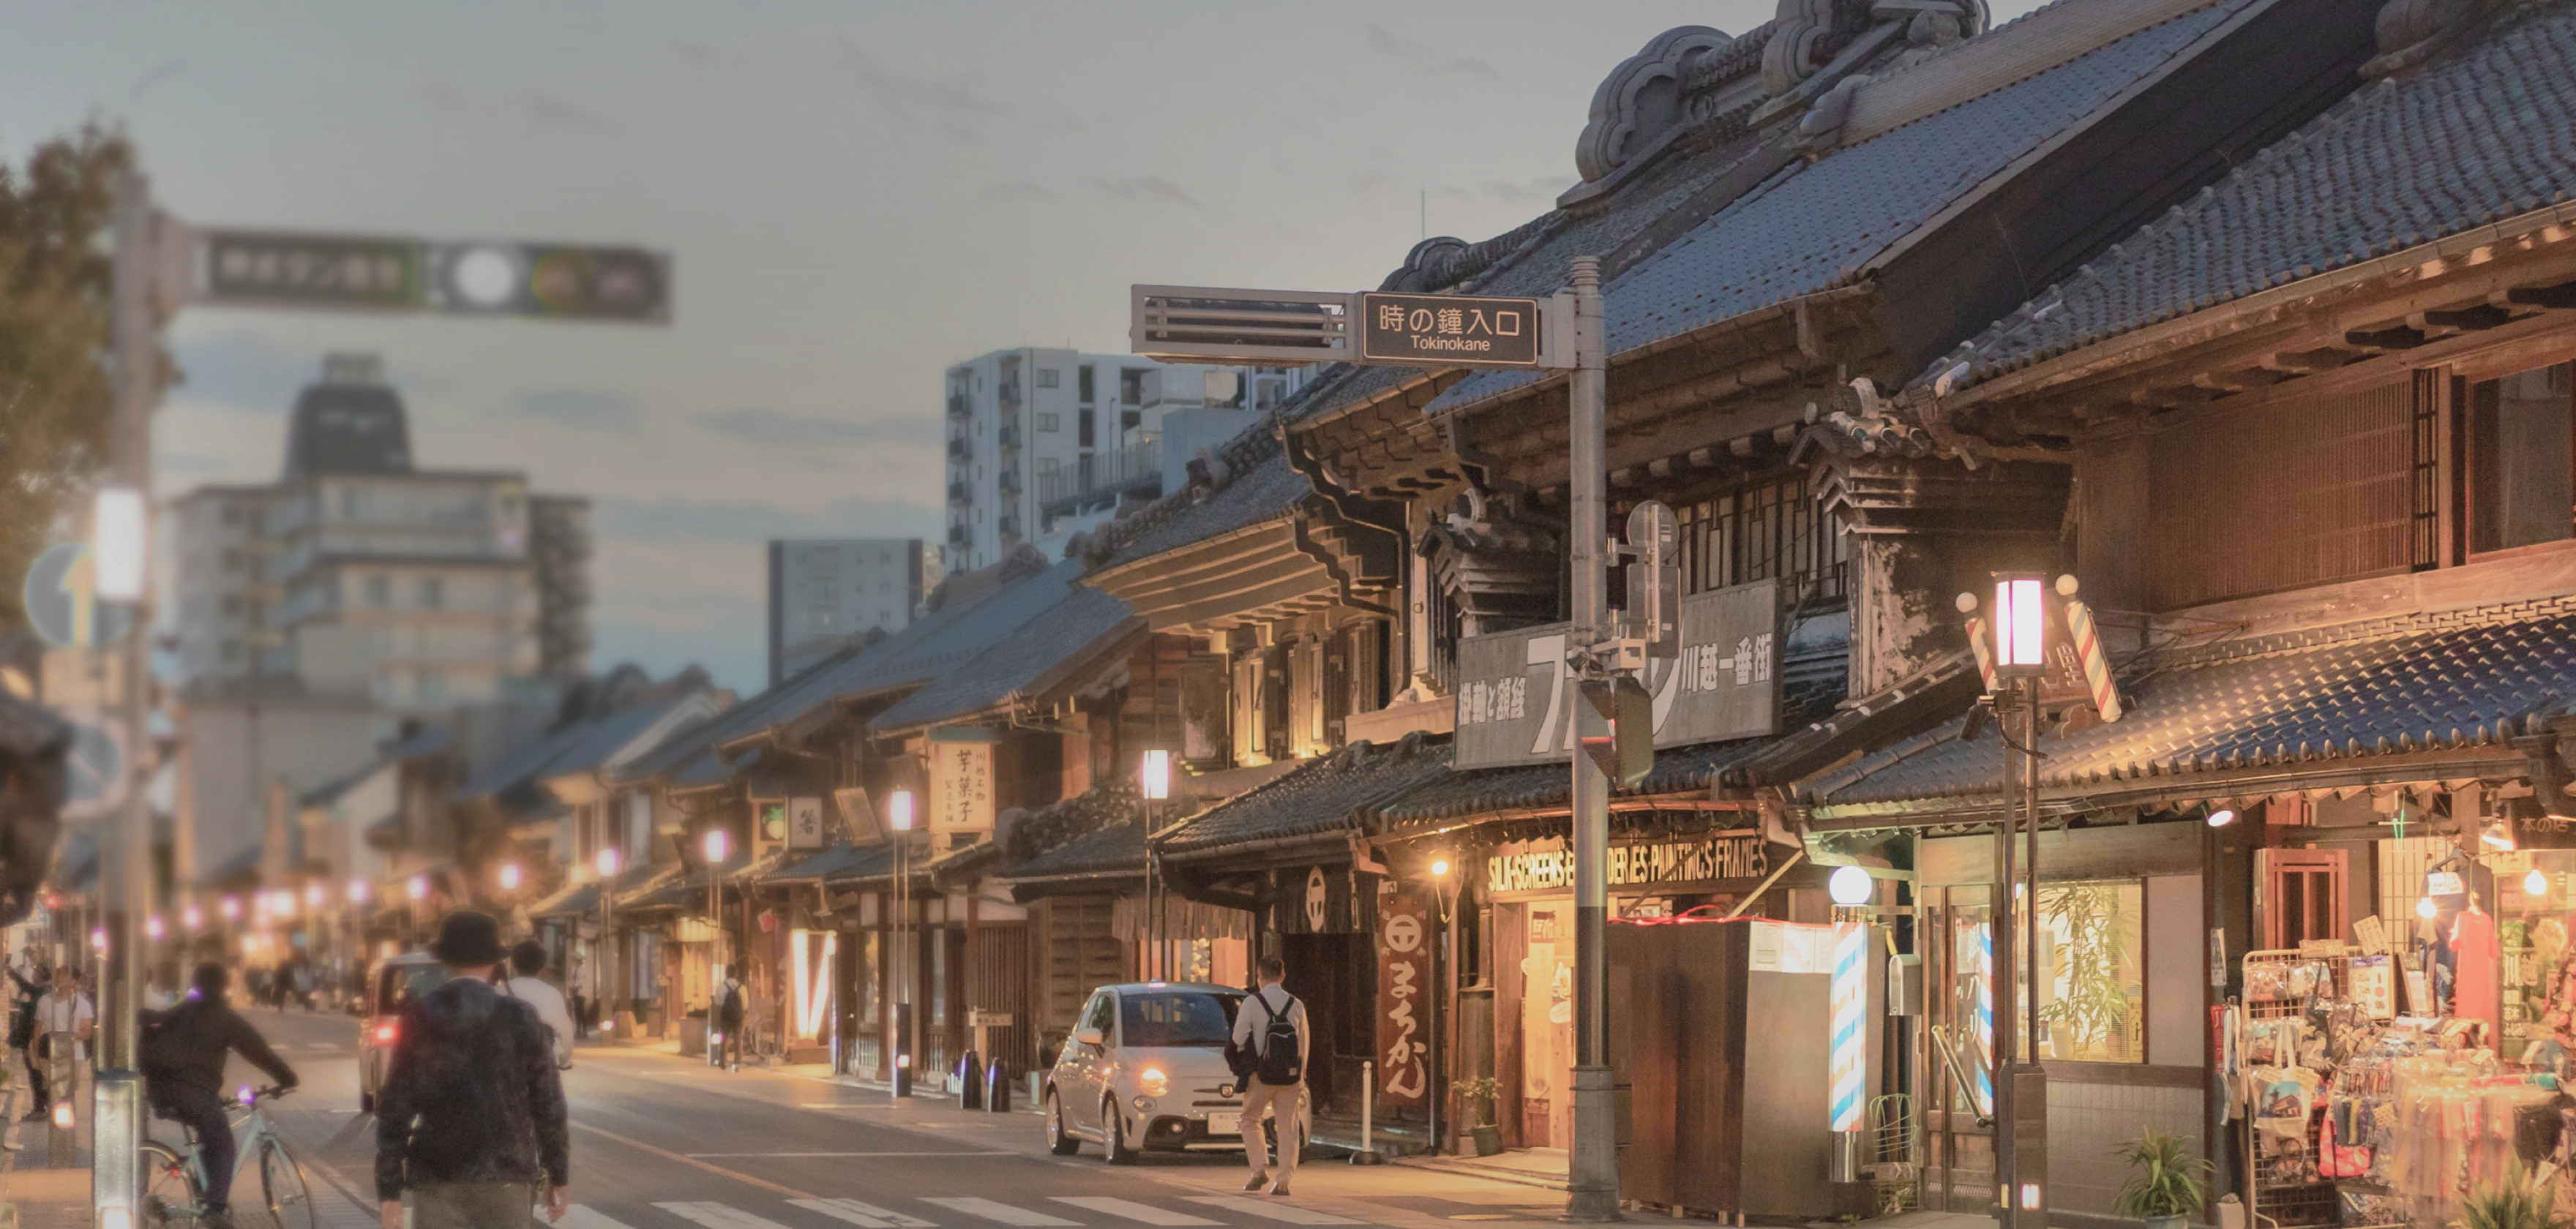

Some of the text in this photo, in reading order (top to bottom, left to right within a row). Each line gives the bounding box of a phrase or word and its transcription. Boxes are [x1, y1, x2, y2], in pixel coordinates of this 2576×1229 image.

[1379, 304, 1520, 337] 時の鐘入口
[1410, 334, 1491, 352] Tokinokane
[1682, 633, 1772, 692] 川越一番街
[956, 749, 973, 822] 芋菓子
[1488, 850, 1565, 892] SILK-SCREENS
[1715, 838, 1768, 879] FRAMES
[1385, 961, 1426, 1099] まちかん
